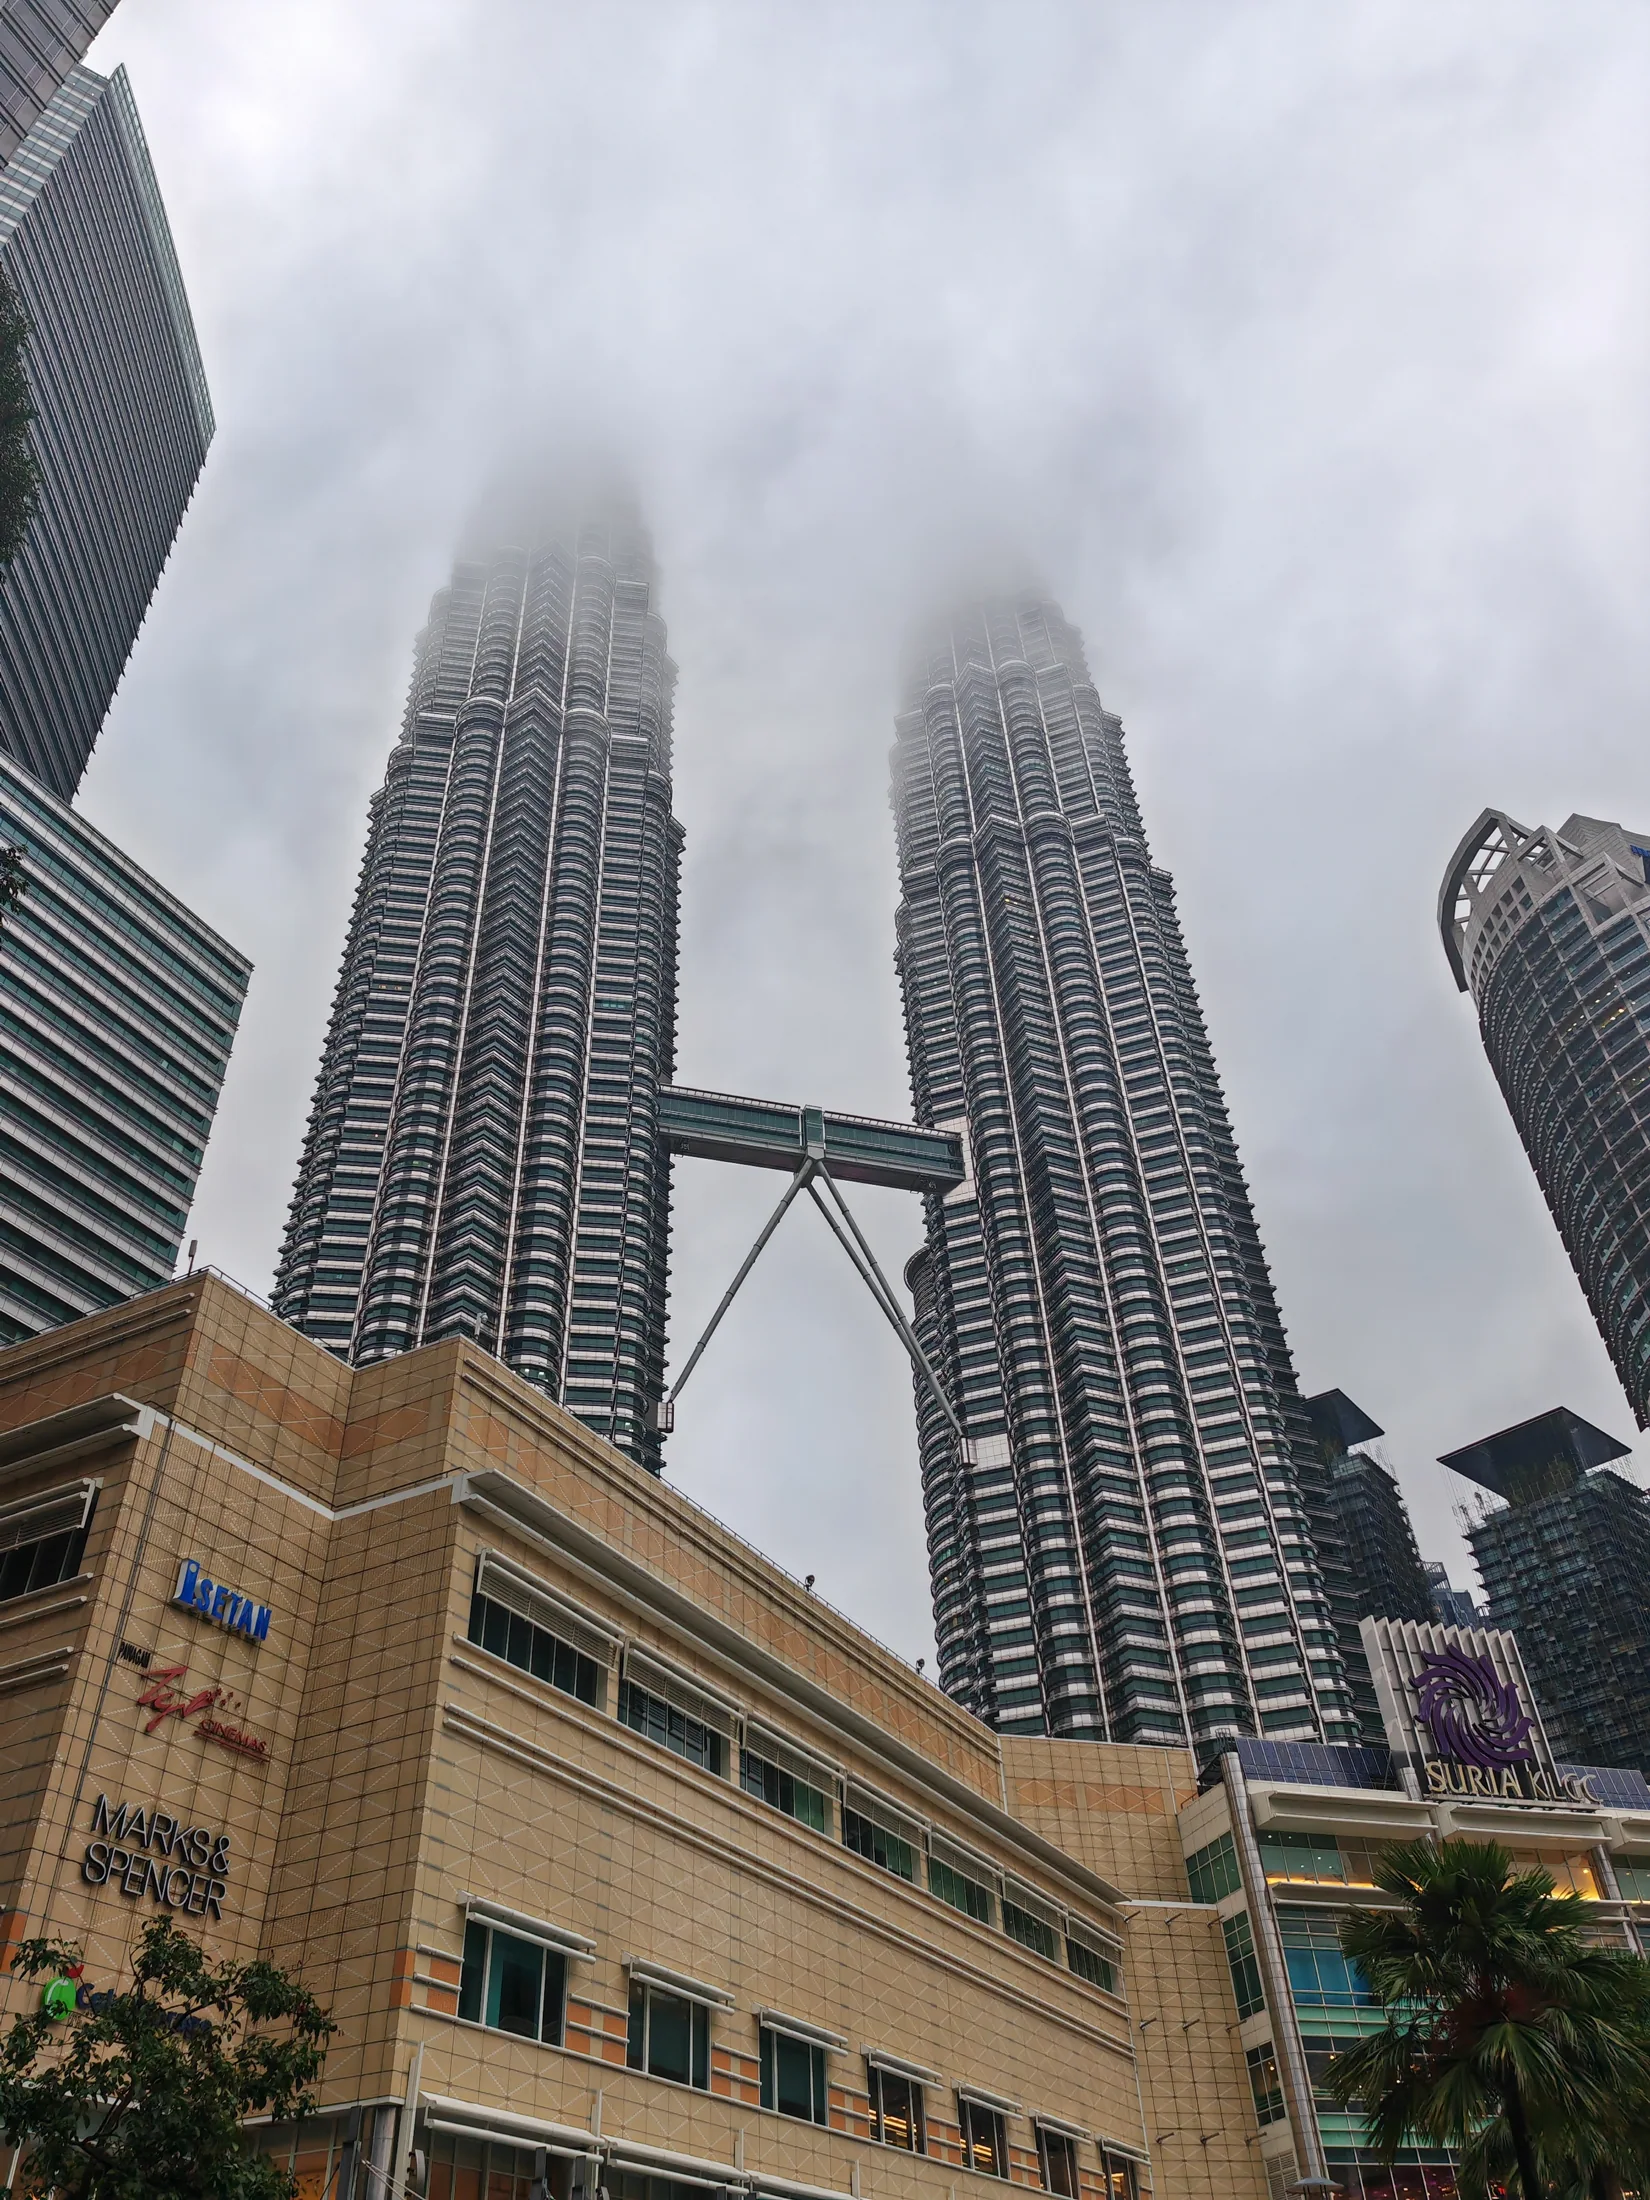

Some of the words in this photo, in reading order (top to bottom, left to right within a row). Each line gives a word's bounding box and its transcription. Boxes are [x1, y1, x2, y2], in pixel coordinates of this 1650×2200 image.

[200, 1718, 267, 1753] CINEMAS
[1425, 1760, 1524, 1799] SURIA
[1527, 1768, 1603, 1803] KLCC
[83, 1841, 227, 1921] SPENCER
